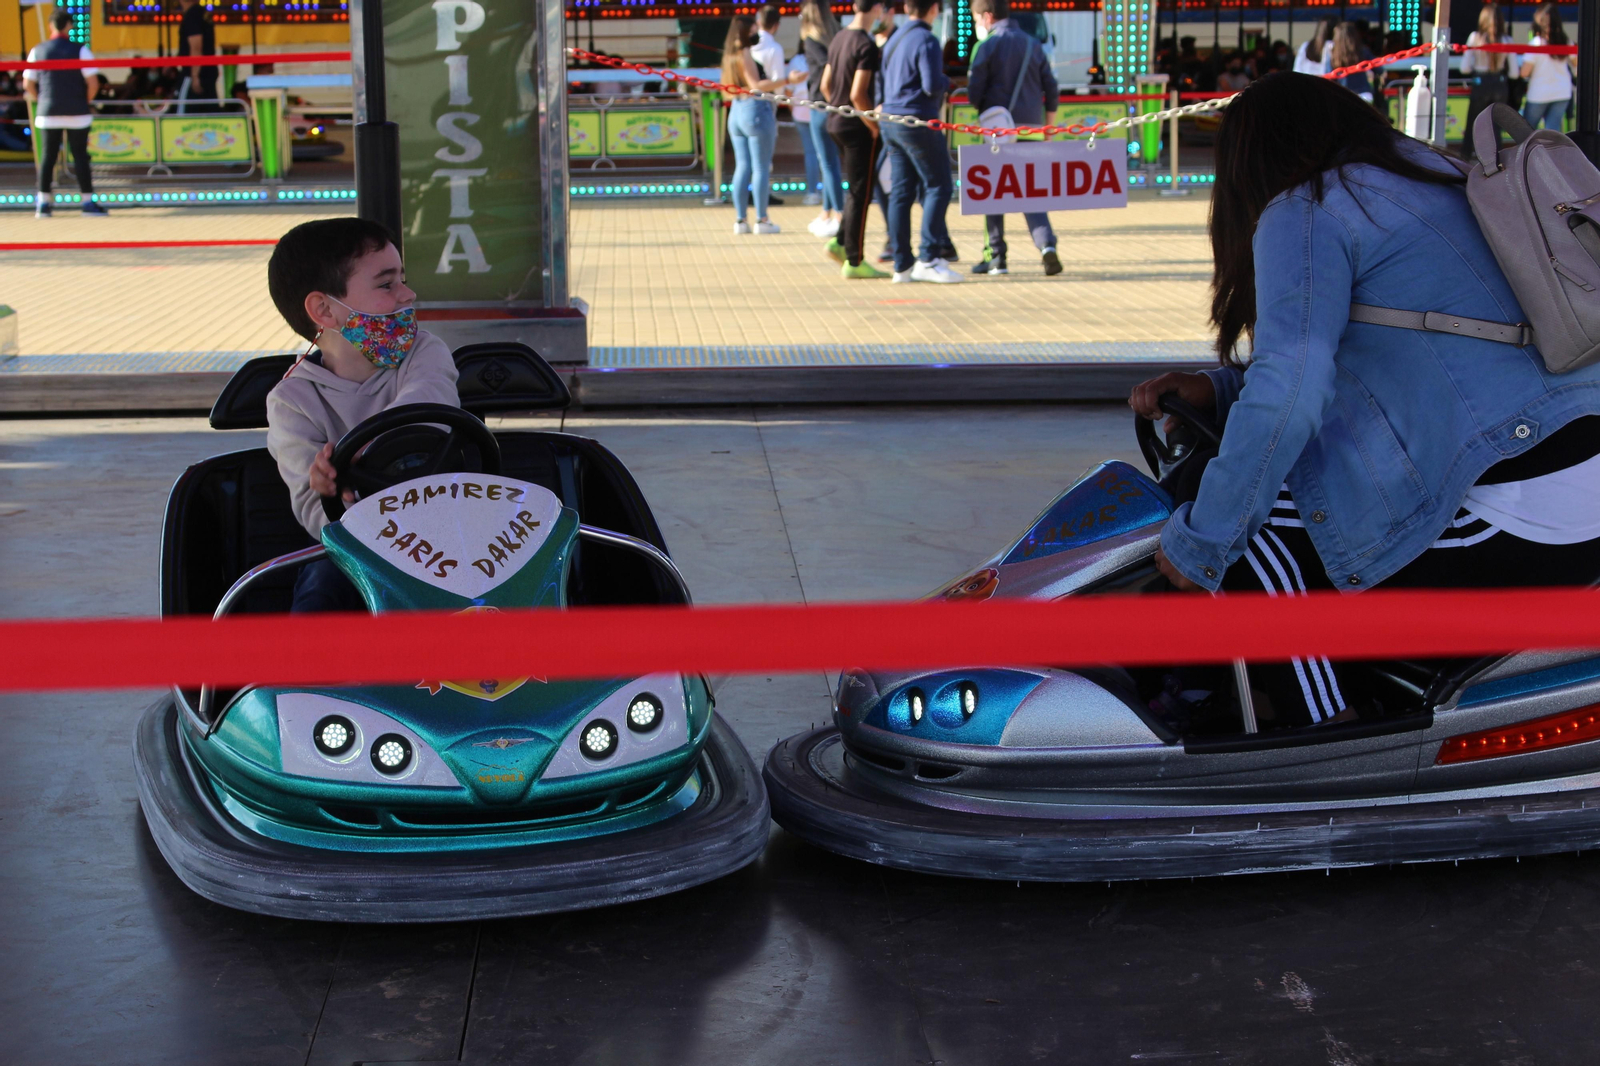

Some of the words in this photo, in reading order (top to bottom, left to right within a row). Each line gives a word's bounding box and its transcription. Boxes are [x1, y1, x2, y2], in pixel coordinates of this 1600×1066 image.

[431, 0, 492, 274] PISTA
[966, 159, 1122, 201] SALIDA
[378, 482, 526, 515] RAMIREZ
[375, 519, 459, 578] PARIS
[471, 510, 541, 579] DAKAR
[1023, 505, 1118, 557] DAKAR
